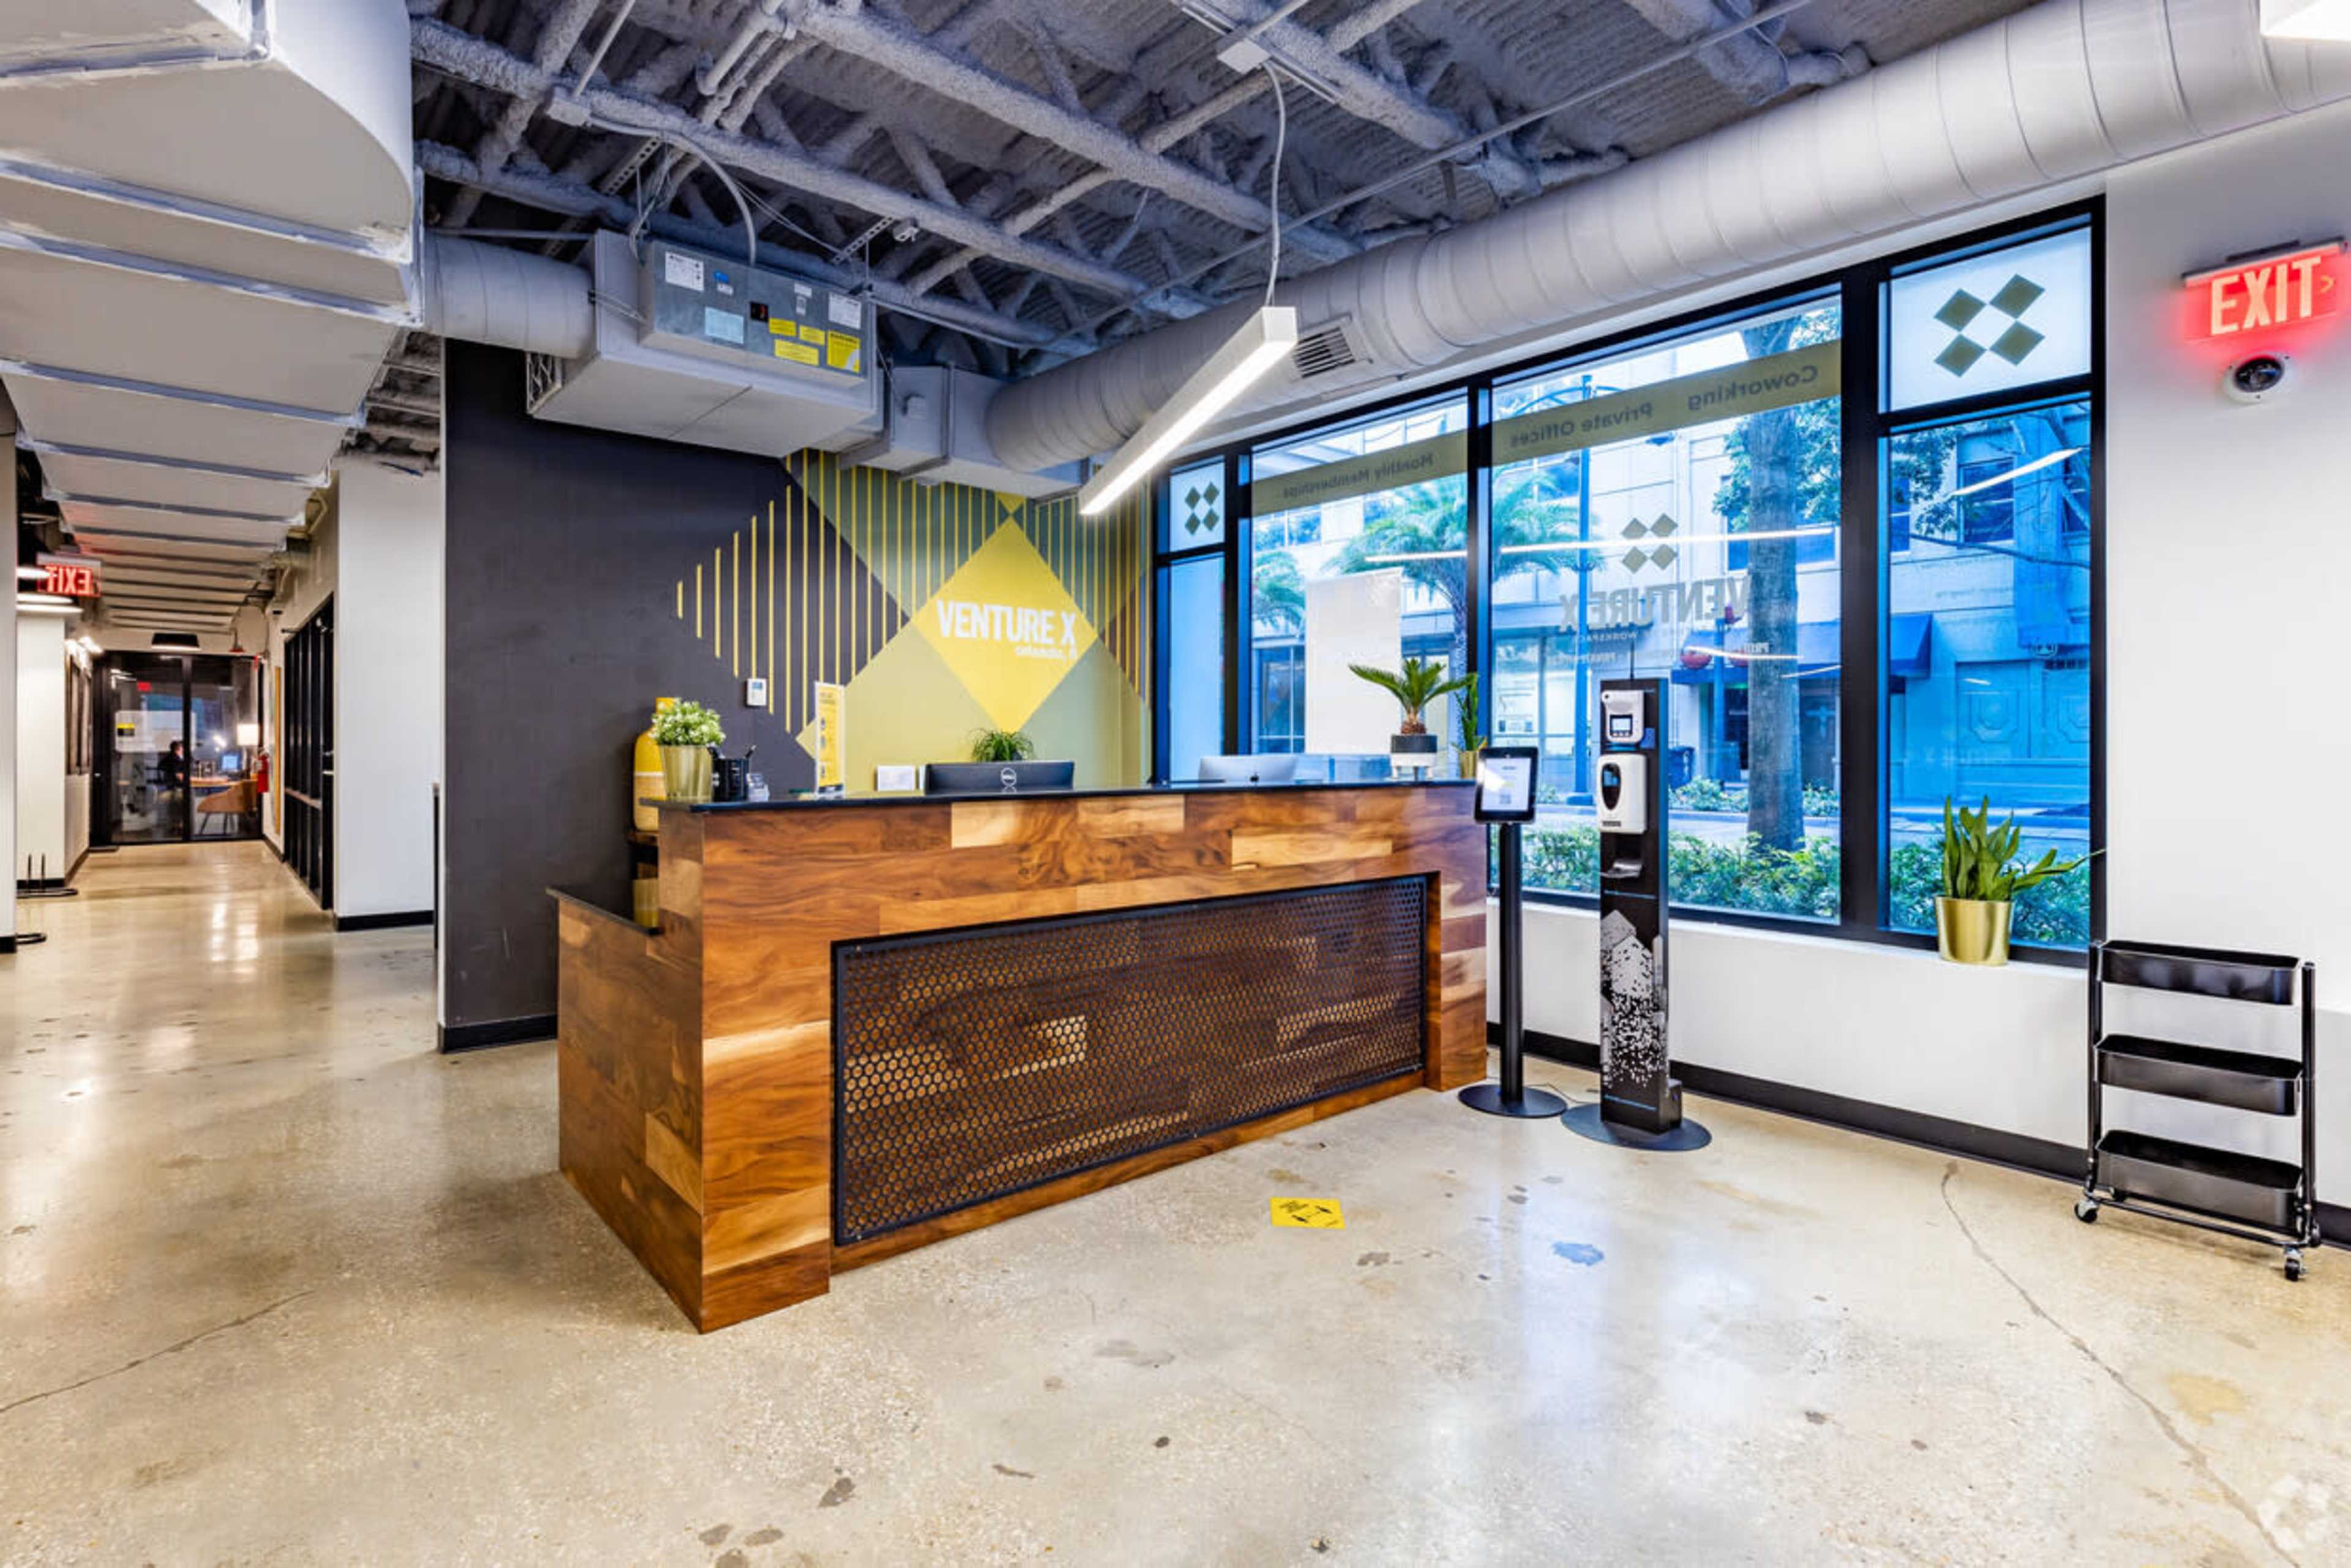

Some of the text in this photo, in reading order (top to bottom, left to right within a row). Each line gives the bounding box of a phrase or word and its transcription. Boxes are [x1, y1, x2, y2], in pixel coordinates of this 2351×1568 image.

[2211, 257, 2321, 336] EXIT
[937, 599, 1077, 647] VENTURE X
